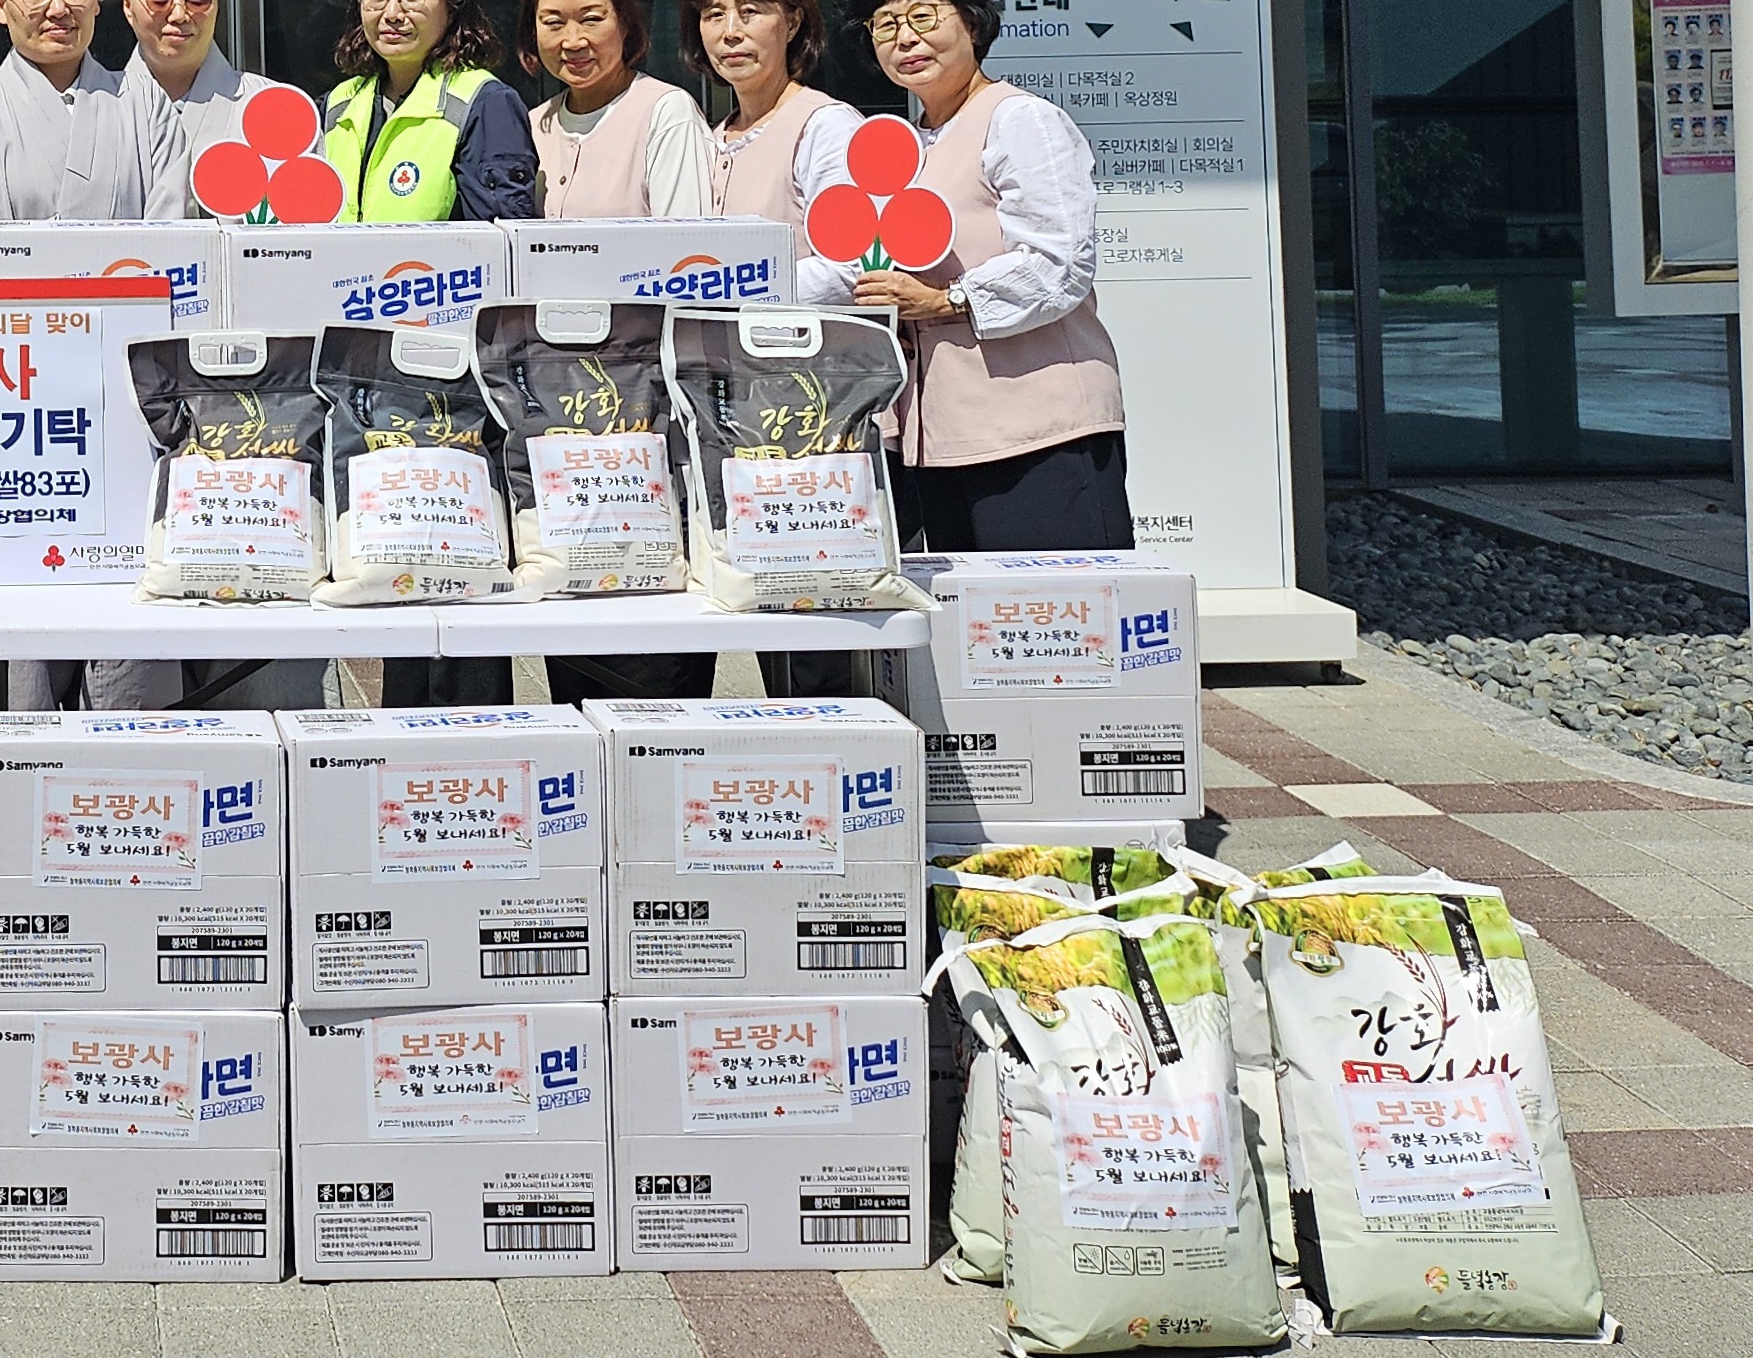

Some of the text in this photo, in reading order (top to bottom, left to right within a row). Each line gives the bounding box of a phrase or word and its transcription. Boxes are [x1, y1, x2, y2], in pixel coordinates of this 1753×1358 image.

[999, 19, 1069, 37] mation
[1069, 93, 1109, 108] 북카페
[1124, 91, 1178, 106] 옥상정원
[1097, 137, 1234, 154] 주민자치회실 회의실
[1111, 158, 1166, 174] 실버카페
[260, 248, 312, 260] Samyang
[547, 243, 599, 254] Samyang
[1102, 248, 1183, 263] 근로자휴게실
[342, 263, 484, 321] 삼양라면
[45, 312, 91, 334] 맞이
[558, 386, 624, 424] 강화
[0, 407, 92, 457] 기탁
[759, 406, 831, 441] 강화
[194, 469, 288, 496] 보광사
[754, 470, 855, 495] 보광사
[199, 496, 278, 511] 행복 가득한
[761, 499, 846, 516] 행복 가득한
[192, 513, 287, 528] 5월 보내세요!
[755, 517, 856, 534] 5월 보내세요!
[1131, 515, 1193, 531] 복지센터
[991, 601, 1091, 625] 보광사
[998, 629, 1081, 642] 행복 가득한
[992, 646, 1089, 659] 5월 보내세요!
[329, 757, 386, 768] Samyang
[69, 793, 175, 821] 보광사
[75, 824, 162, 839] 행복 가득한
[66, 843, 170, 857] 5월 보내세요!
[1351, 1003, 1460, 1057] 강화
[68, 1041, 175, 1071] 보광사
[74, 1071, 161, 1089] 행복 가득한
[65, 1089, 169, 1107] 5월 보내세요!
[1377, 1095, 1487, 1128] 보광사
[1091, 1111, 1201, 1144] 보광사
[1390, 1132, 1484, 1147] 행복 가득한
[1102, 1147, 1198, 1165] 행복 가득한
[1386, 1151, 1503, 1169] 5월 보내세요!
[1095, 1167, 1208, 1185] 5월 보내세요!
